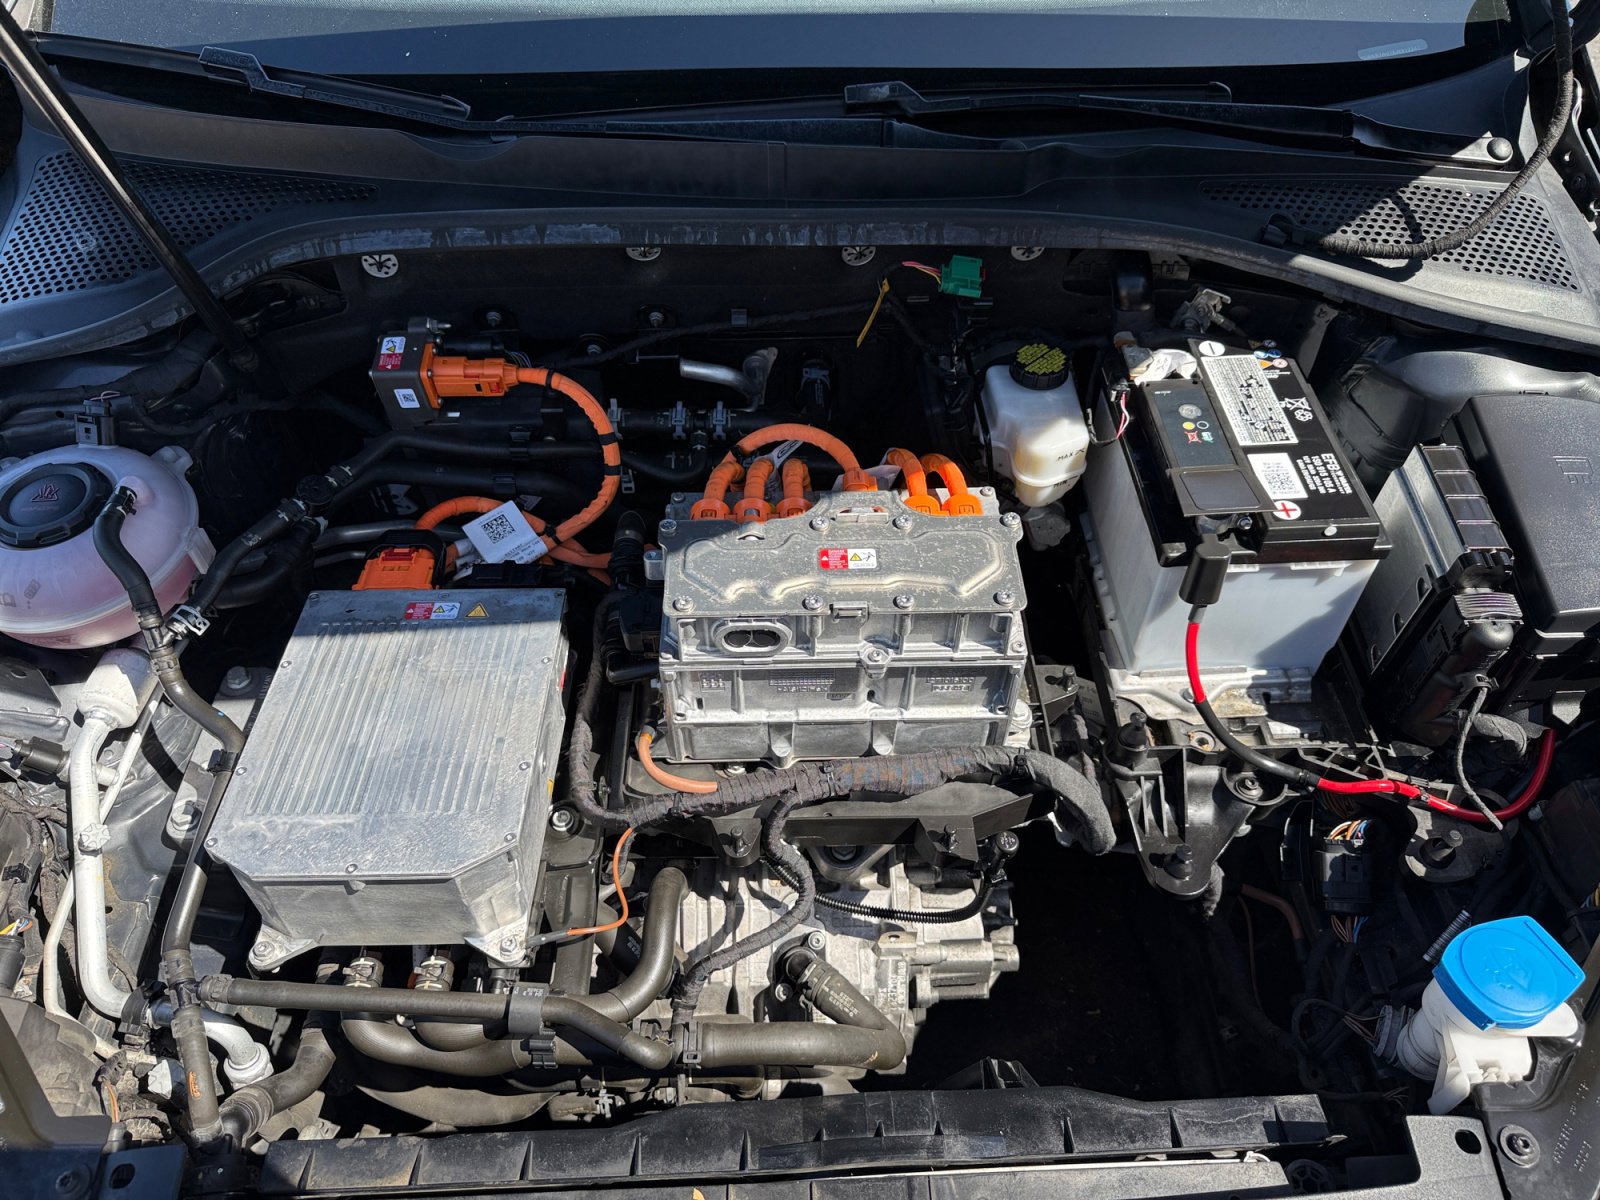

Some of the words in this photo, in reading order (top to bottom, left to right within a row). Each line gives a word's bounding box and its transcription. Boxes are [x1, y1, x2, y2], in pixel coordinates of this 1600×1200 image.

[1057, 452, 1074, 461] MAX
[1321, 453, 1340, 470] EFB
[1053, 480, 1067, 488] MIN
